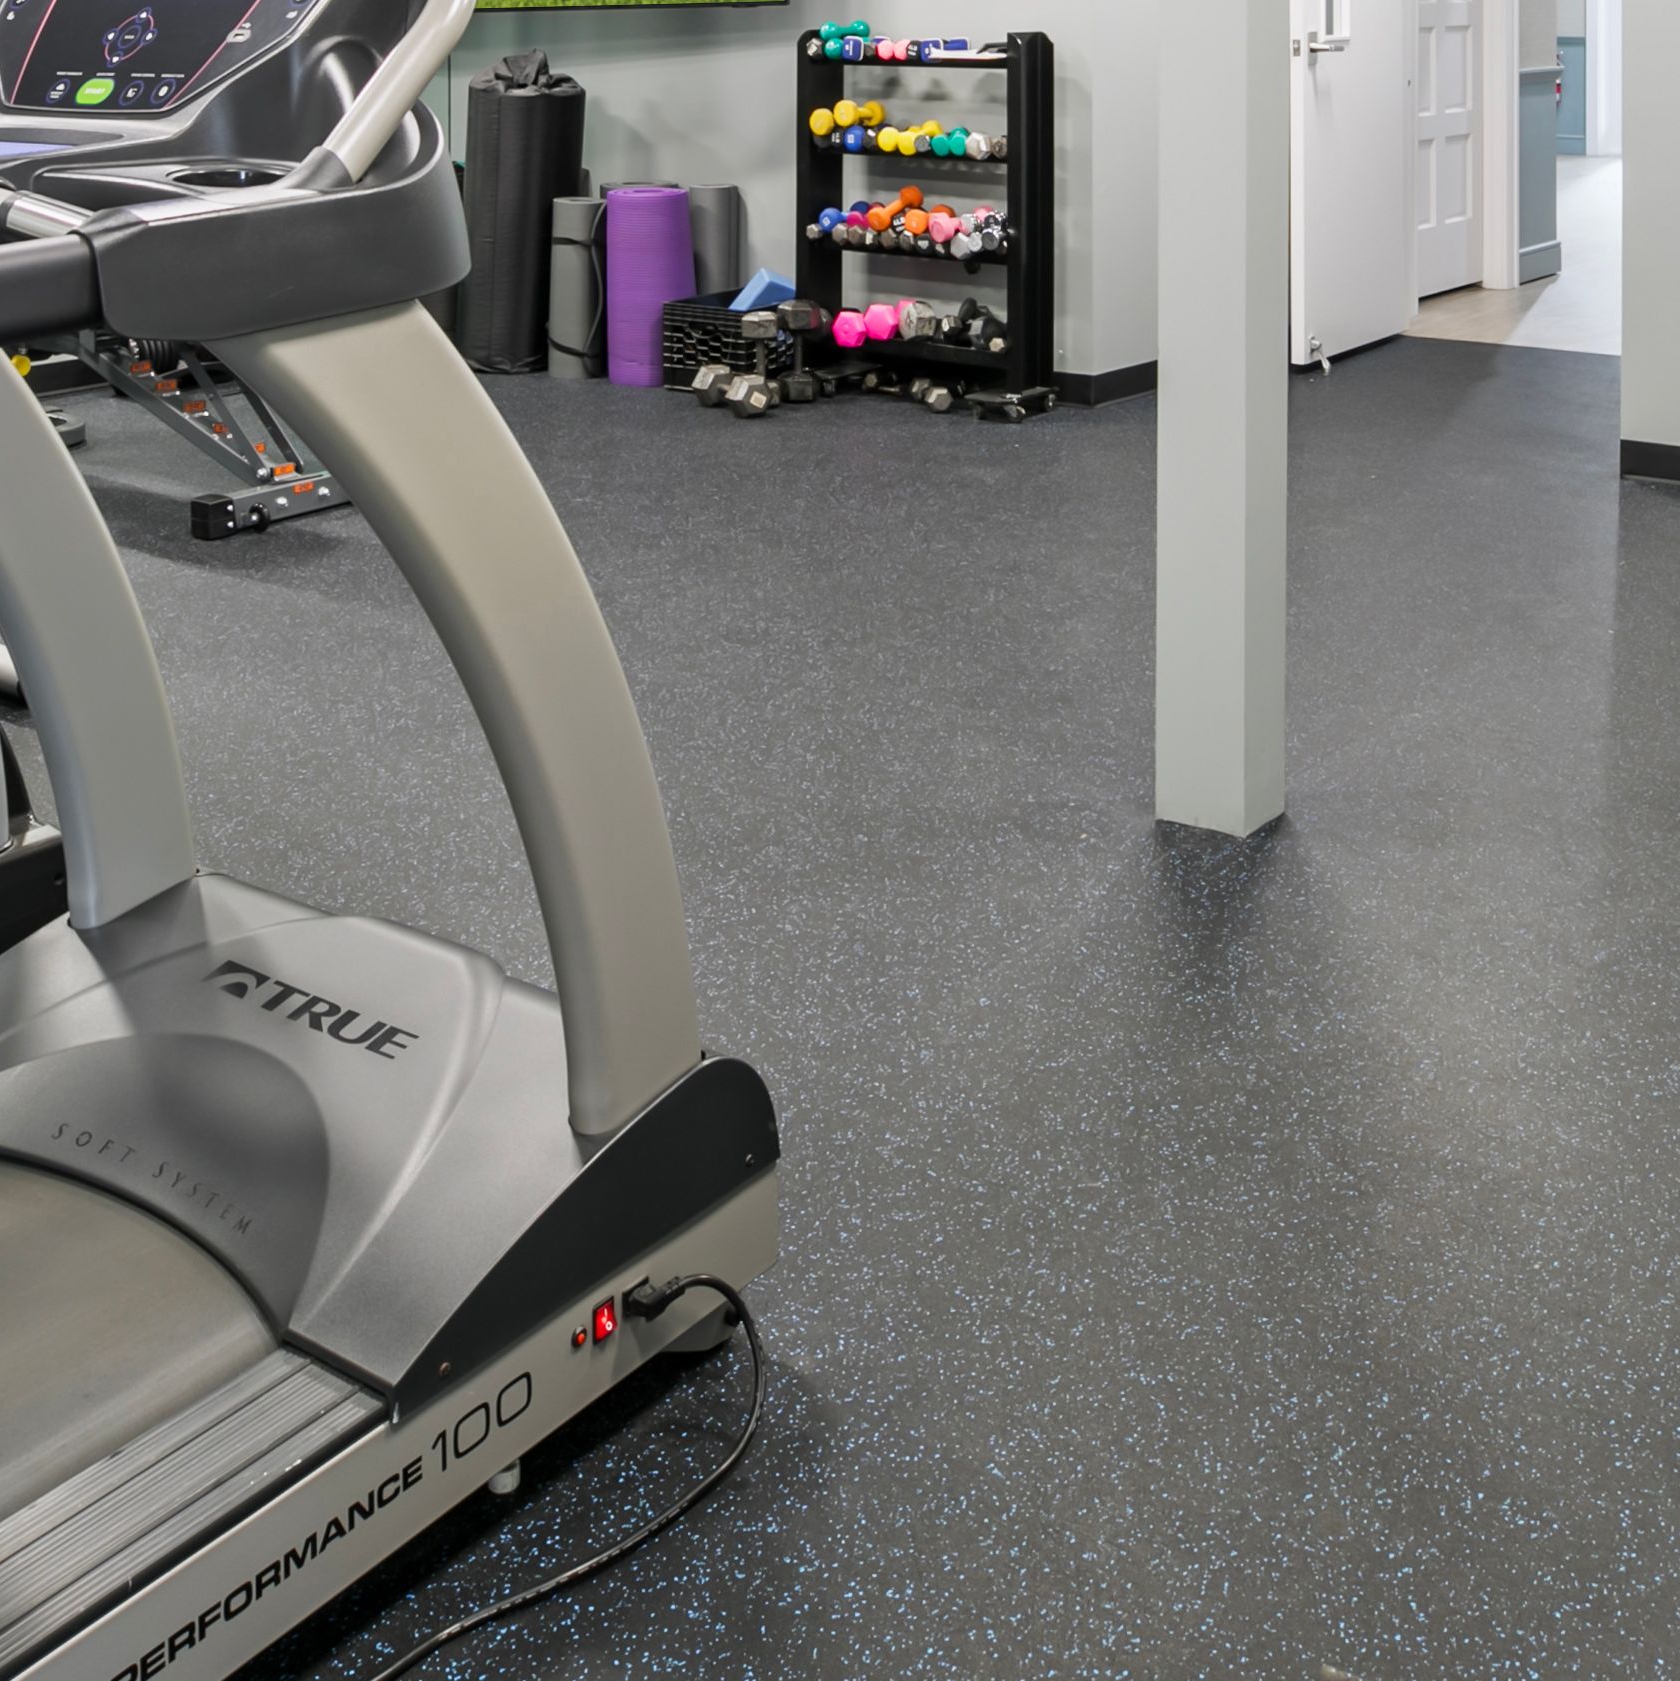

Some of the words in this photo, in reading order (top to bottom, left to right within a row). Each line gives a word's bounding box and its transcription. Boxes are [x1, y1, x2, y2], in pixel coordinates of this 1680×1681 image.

[260, 979, 420, 1061] TRUE
[50, 1121, 137, 1164] SOFT
[151, 1160, 252, 1236] SYSTEM
[431, 1371, 533, 1472] 100
